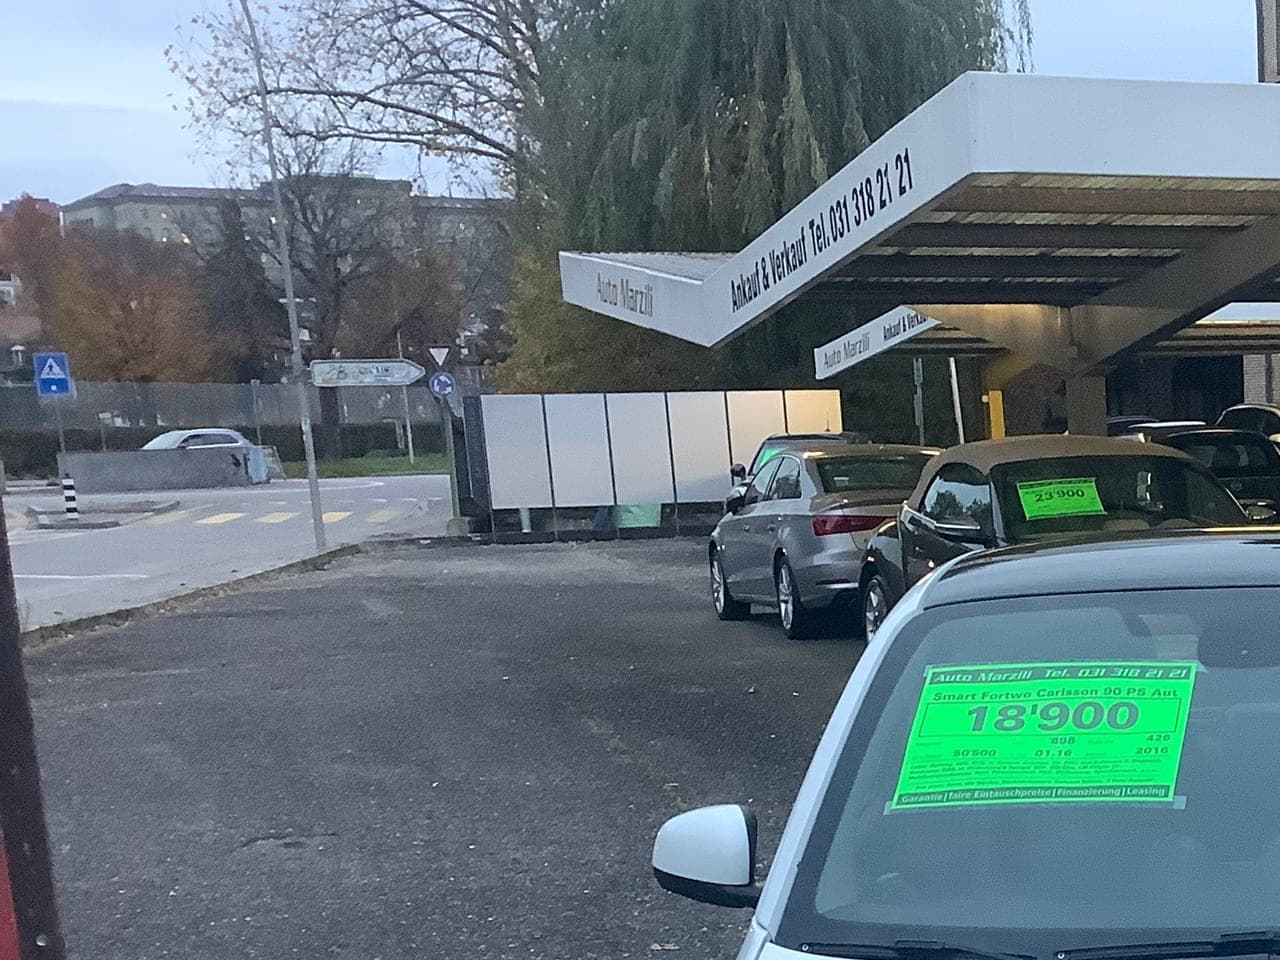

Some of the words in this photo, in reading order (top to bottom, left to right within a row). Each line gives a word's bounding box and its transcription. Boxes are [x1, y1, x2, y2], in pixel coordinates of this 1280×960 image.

[731, 261, 762, 312] Ankauf
[761, 257, 770, 291] &
[769, 227, 807, 284] Verkauf
[809, 212, 830, 257] Tel.
[829, 194, 850, 243] 031
[852, 177, 875, 226] 318
[876, 162, 892, 210] 21
[895, 147, 913, 196] 21
[597, 272, 618, 306] Auto
[620, 278, 653, 317] Marzili
[824, 349, 841, 368] Auto
[843, 332, 870, 359] Marzili
[883, 318, 901, 341] Ankauf
[1035, 488, 1085, 502] 23'900
[935, 673, 972, 682] Auto
[1045, 668, 1070, 678] Tel.
[1078, 668, 1106, 677] 031
[1111, 668, 1141, 677] 318
[1145, 669, 1163, 678] 21
[1168, 669, 1187, 678] 21
[933, 692, 977, 701] Smart
[1037, 687, 1098, 698] Carlsson
[1103, 687, 1122, 696] 90
[1126, 687, 1146, 697] PS
[1151, 688, 1179, 697] Aut
[967, 701, 1140, 733] 18'900
[1135, 746, 1169, 755] 2016
